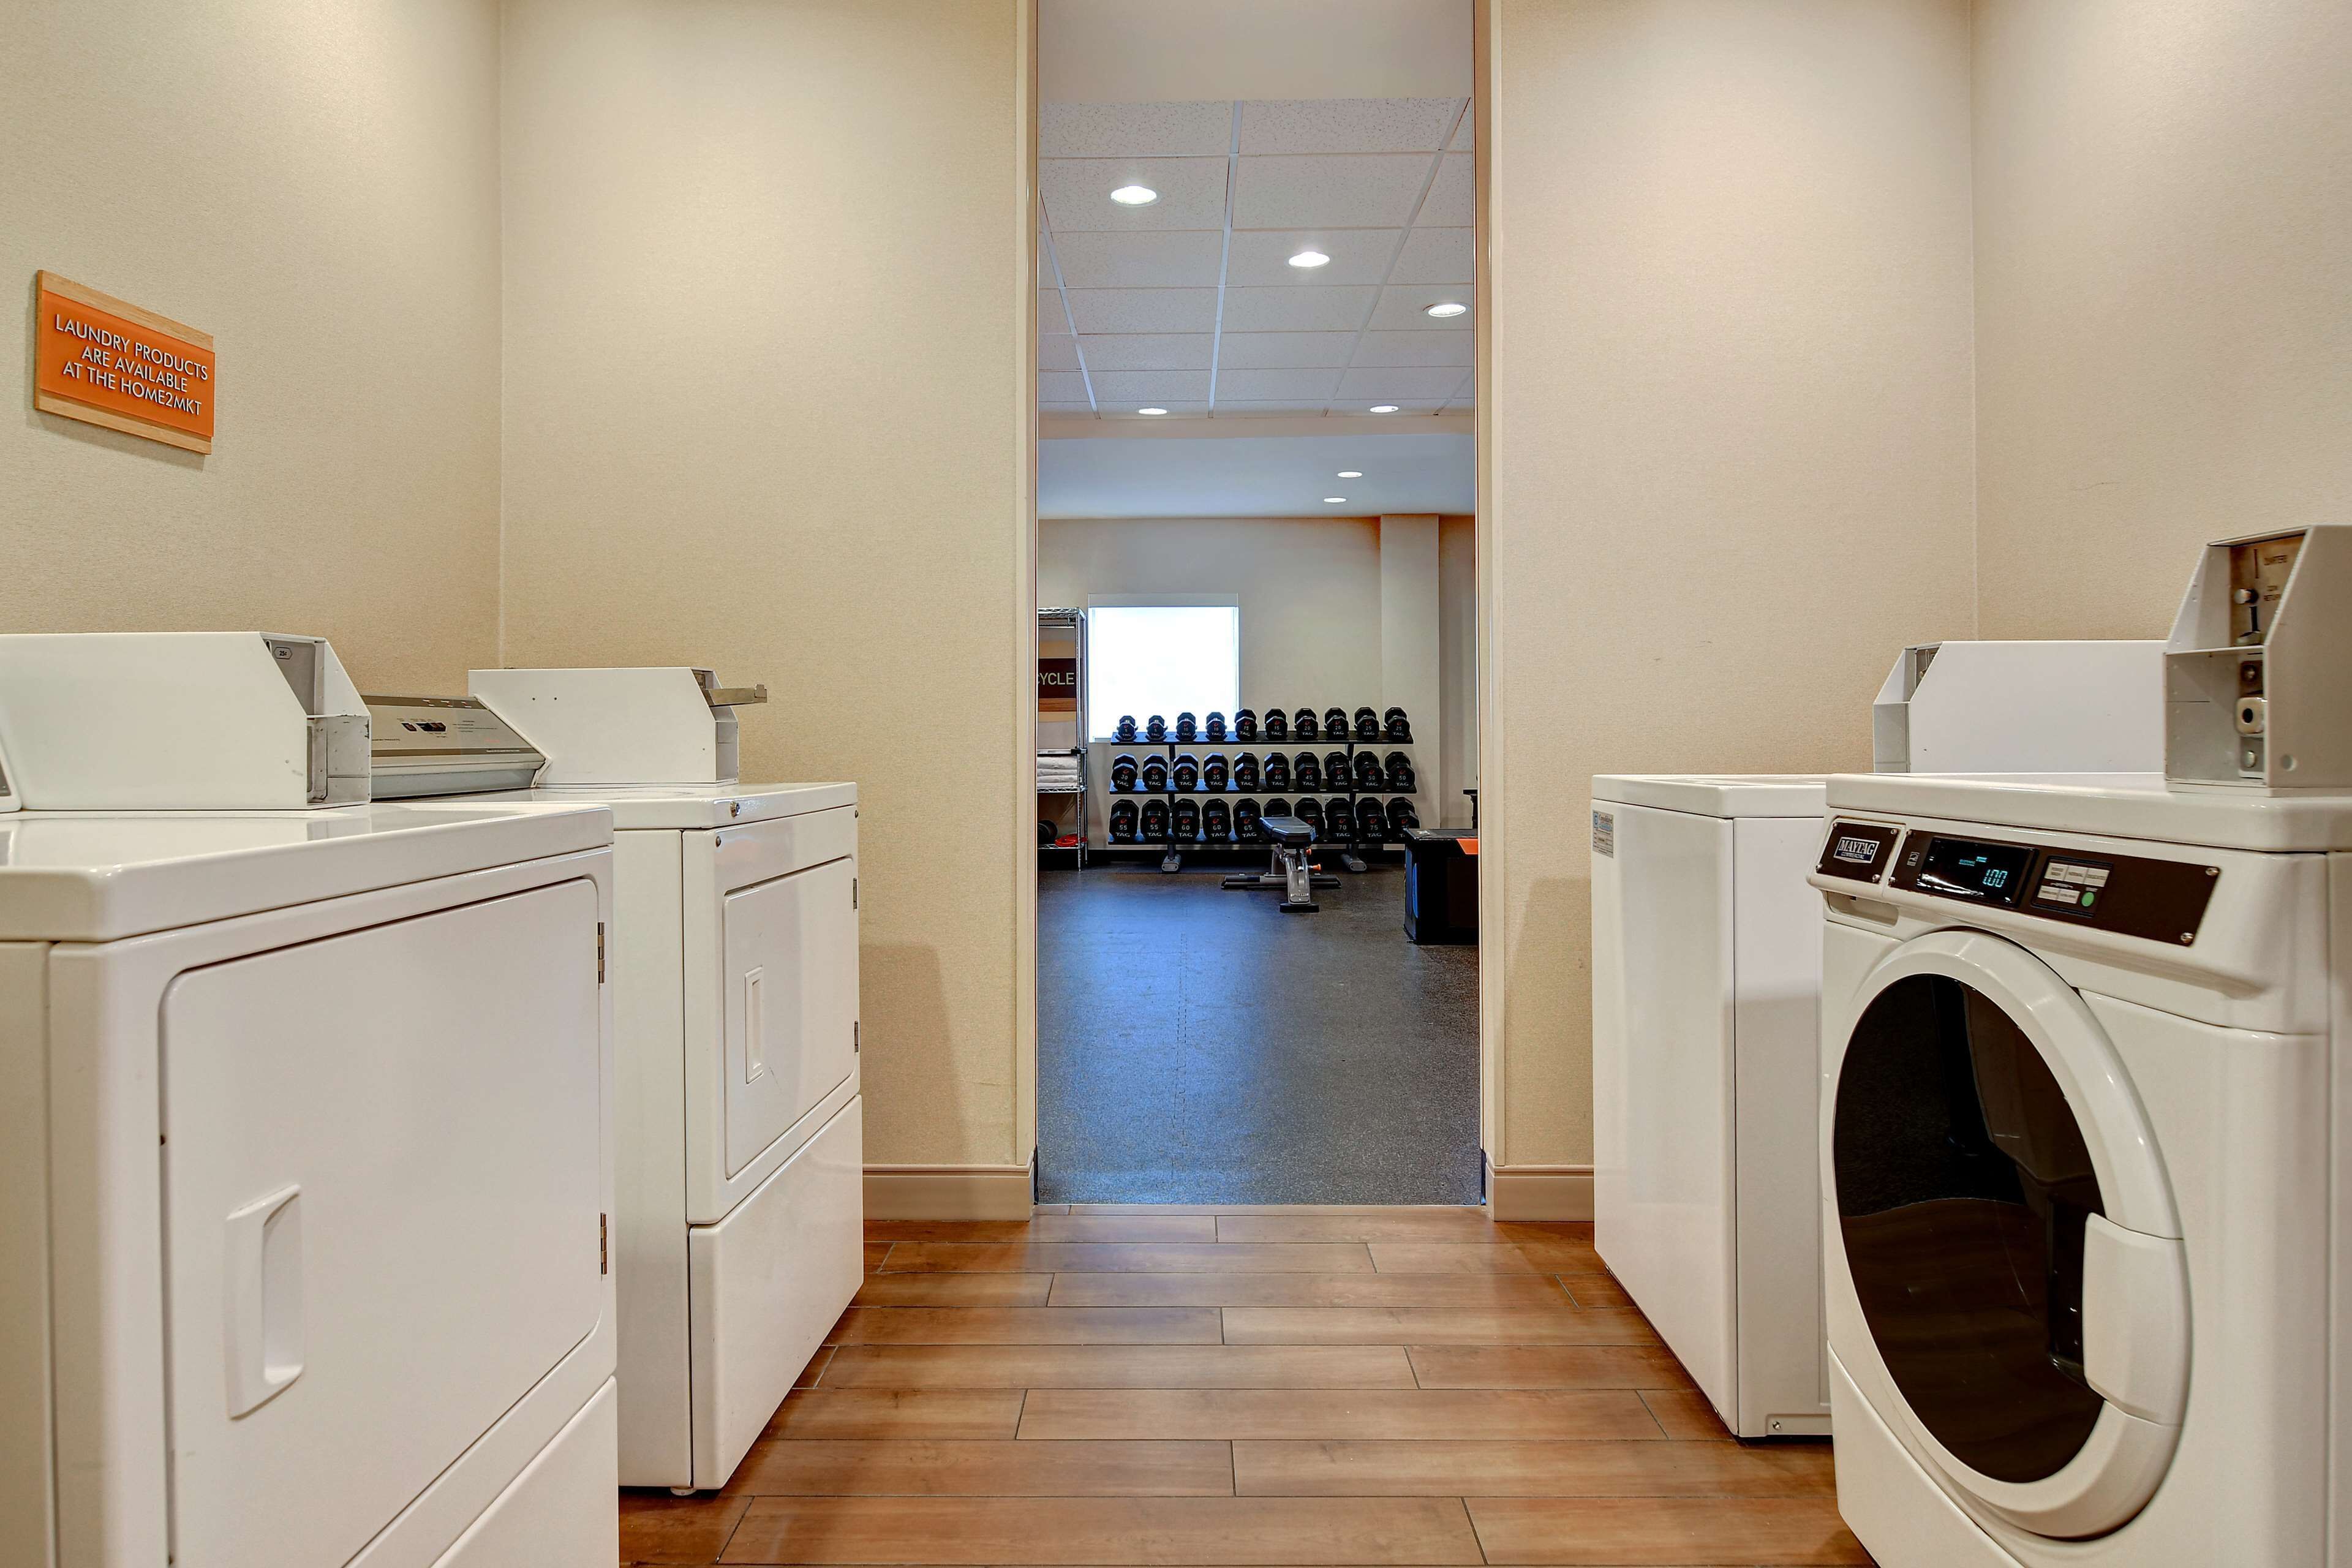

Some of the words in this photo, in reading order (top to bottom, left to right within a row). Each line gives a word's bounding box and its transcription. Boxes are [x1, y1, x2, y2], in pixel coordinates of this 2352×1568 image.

[55, 314, 130, 353] LAUNDRY
[134, 342, 208, 381] PRODUCTS
[81, 346, 110, 368] ARE
[115, 357, 187, 393] AVAILABLE
[62, 361, 81, 379] AT
[87, 366, 116, 390] THE
[121, 379, 202, 415] HOME2MKT
[1038, 672, 1075, 685] YCLE
[1838, 840, 1875, 855] MAYTAG
